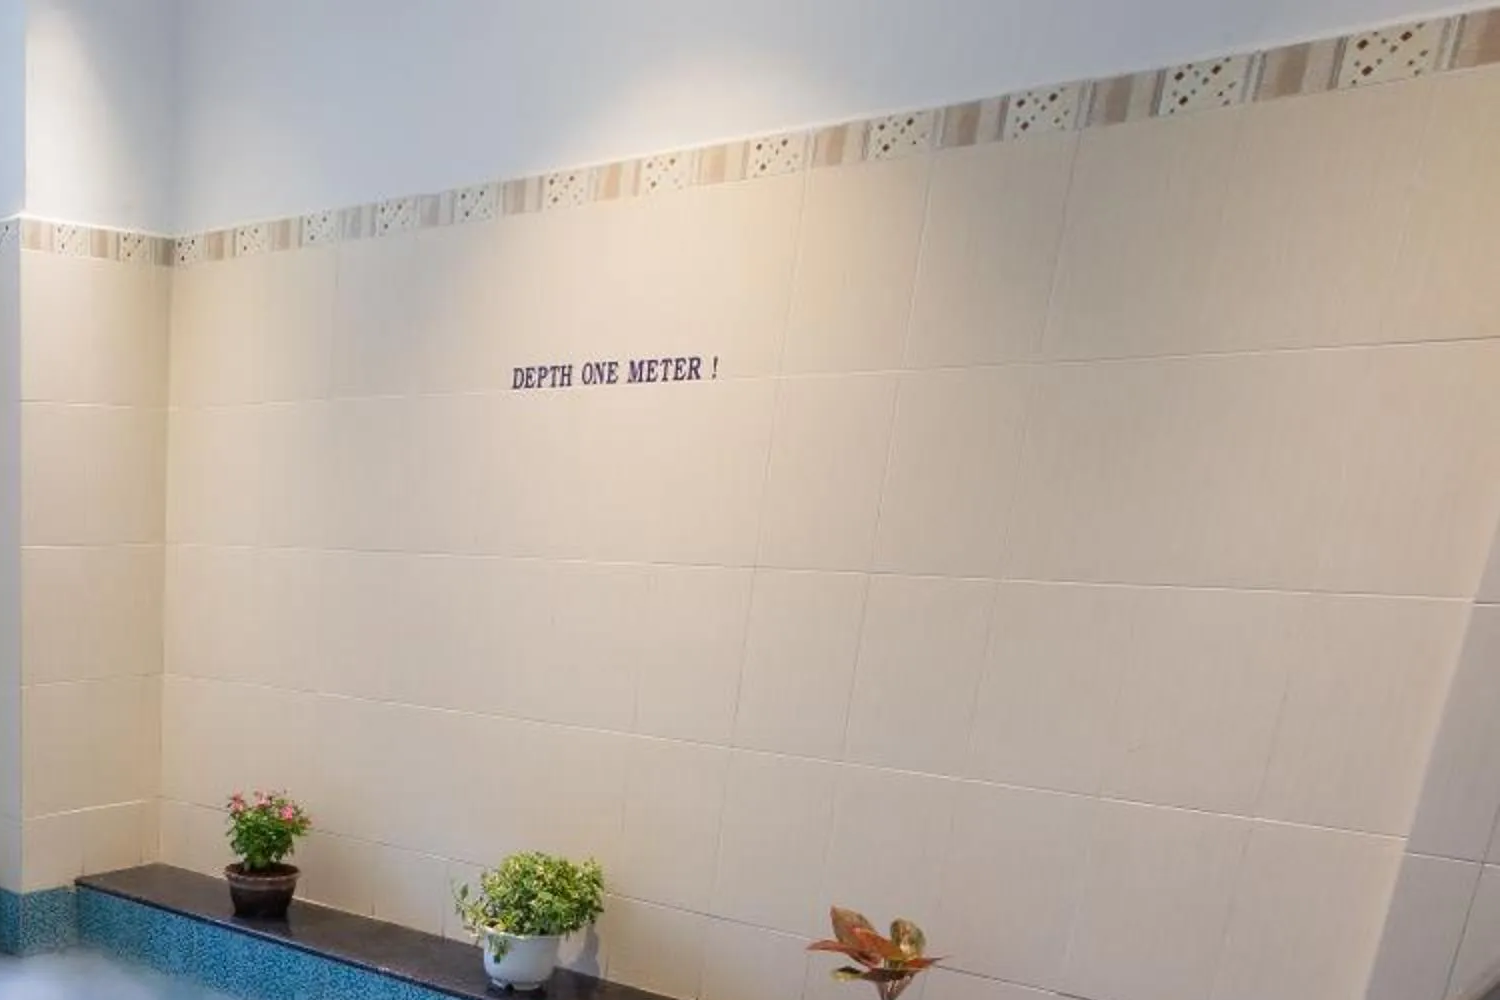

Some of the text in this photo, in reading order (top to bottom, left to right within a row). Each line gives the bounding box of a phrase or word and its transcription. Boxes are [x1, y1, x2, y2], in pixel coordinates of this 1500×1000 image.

[511, 364, 573, 390] DEPTH
[581, 361, 619, 385] ONE
[627, 356, 702, 384] METER
